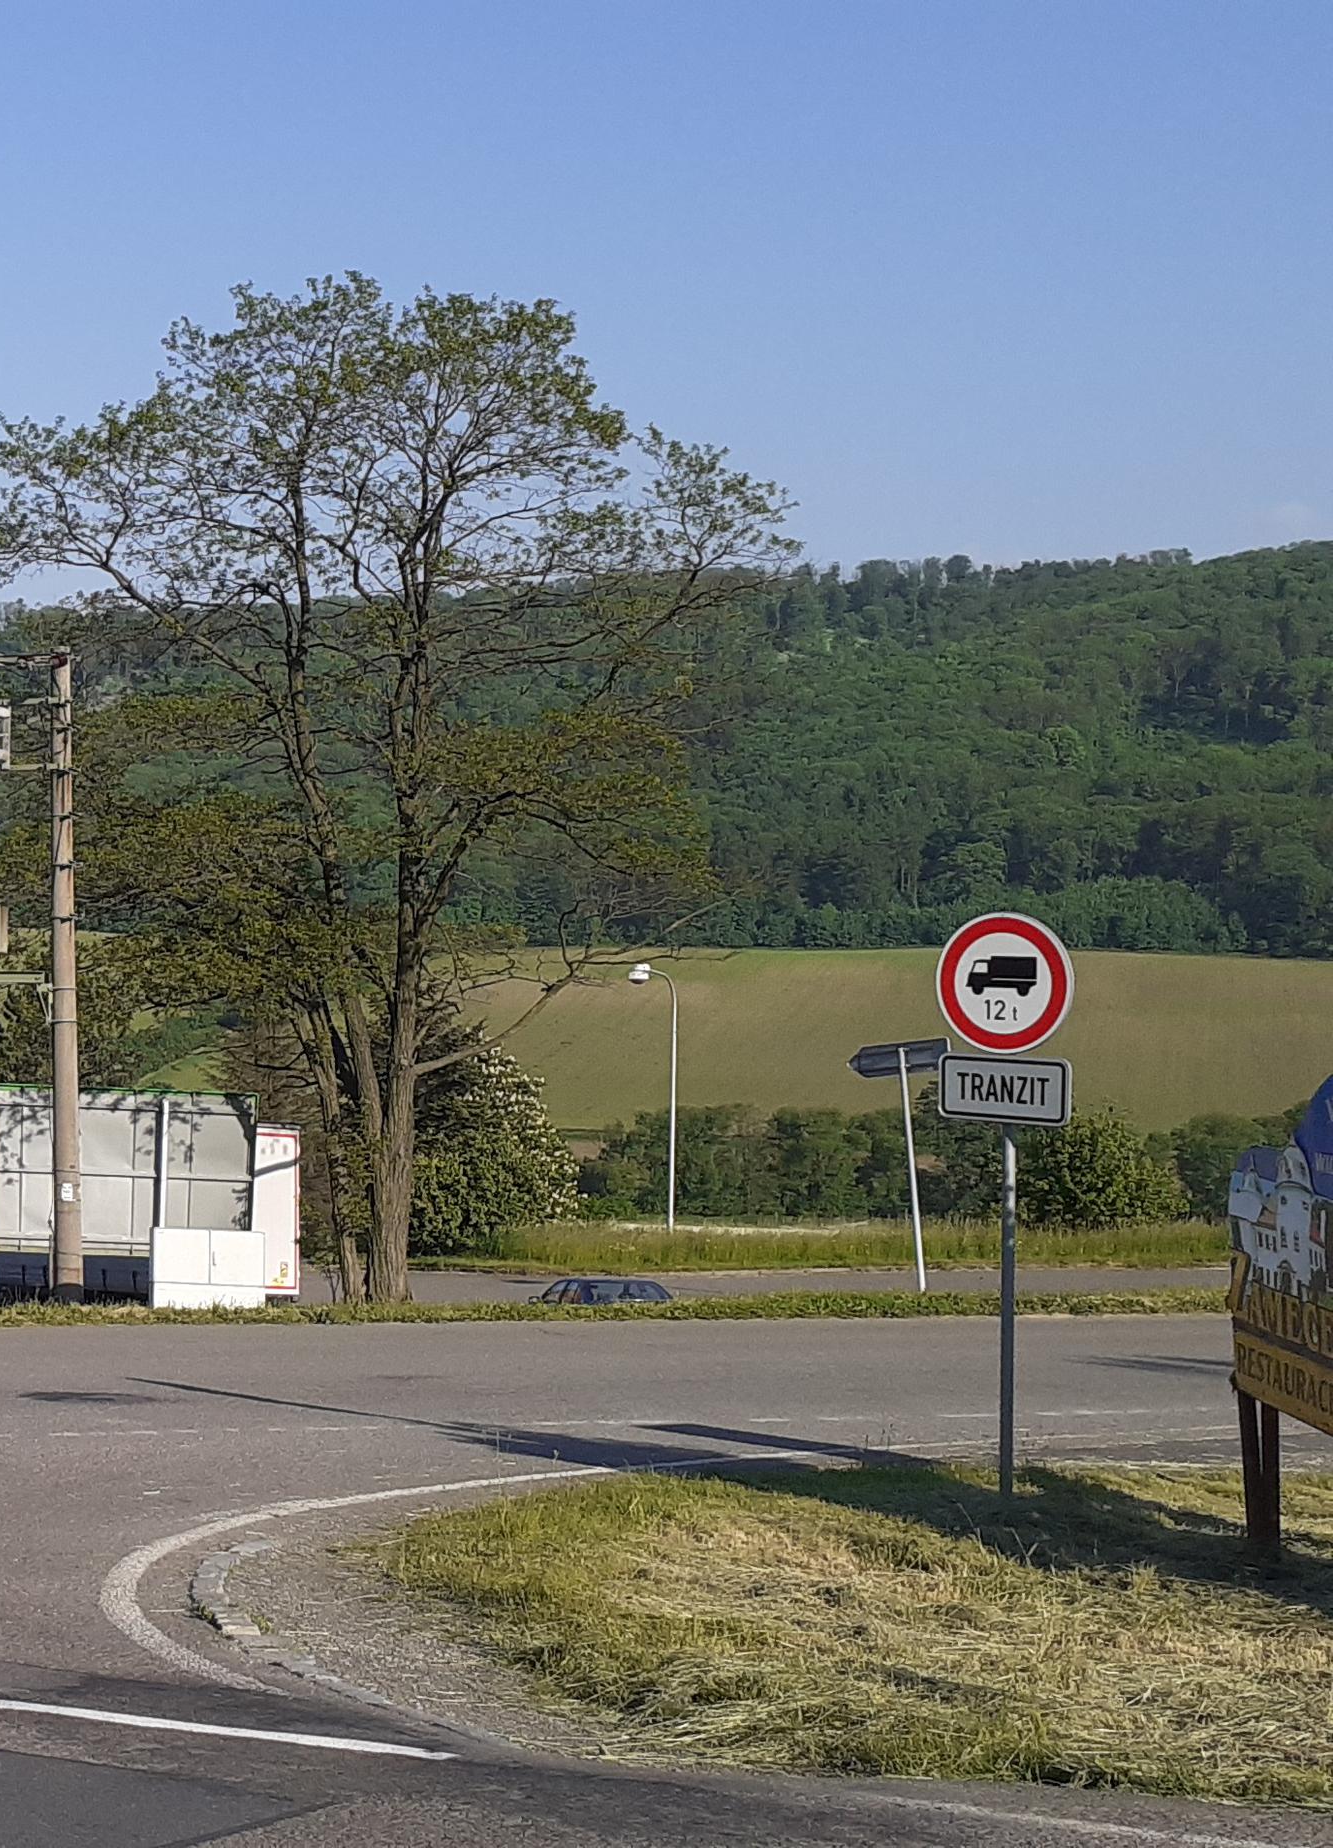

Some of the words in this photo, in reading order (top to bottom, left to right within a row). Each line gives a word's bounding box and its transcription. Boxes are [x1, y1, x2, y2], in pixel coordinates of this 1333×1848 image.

[984, 999, 1006, 1020] 12
[1013, 1006, 1018, 1021] t
[957, 1072, 1050, 1106] TRANZIT
